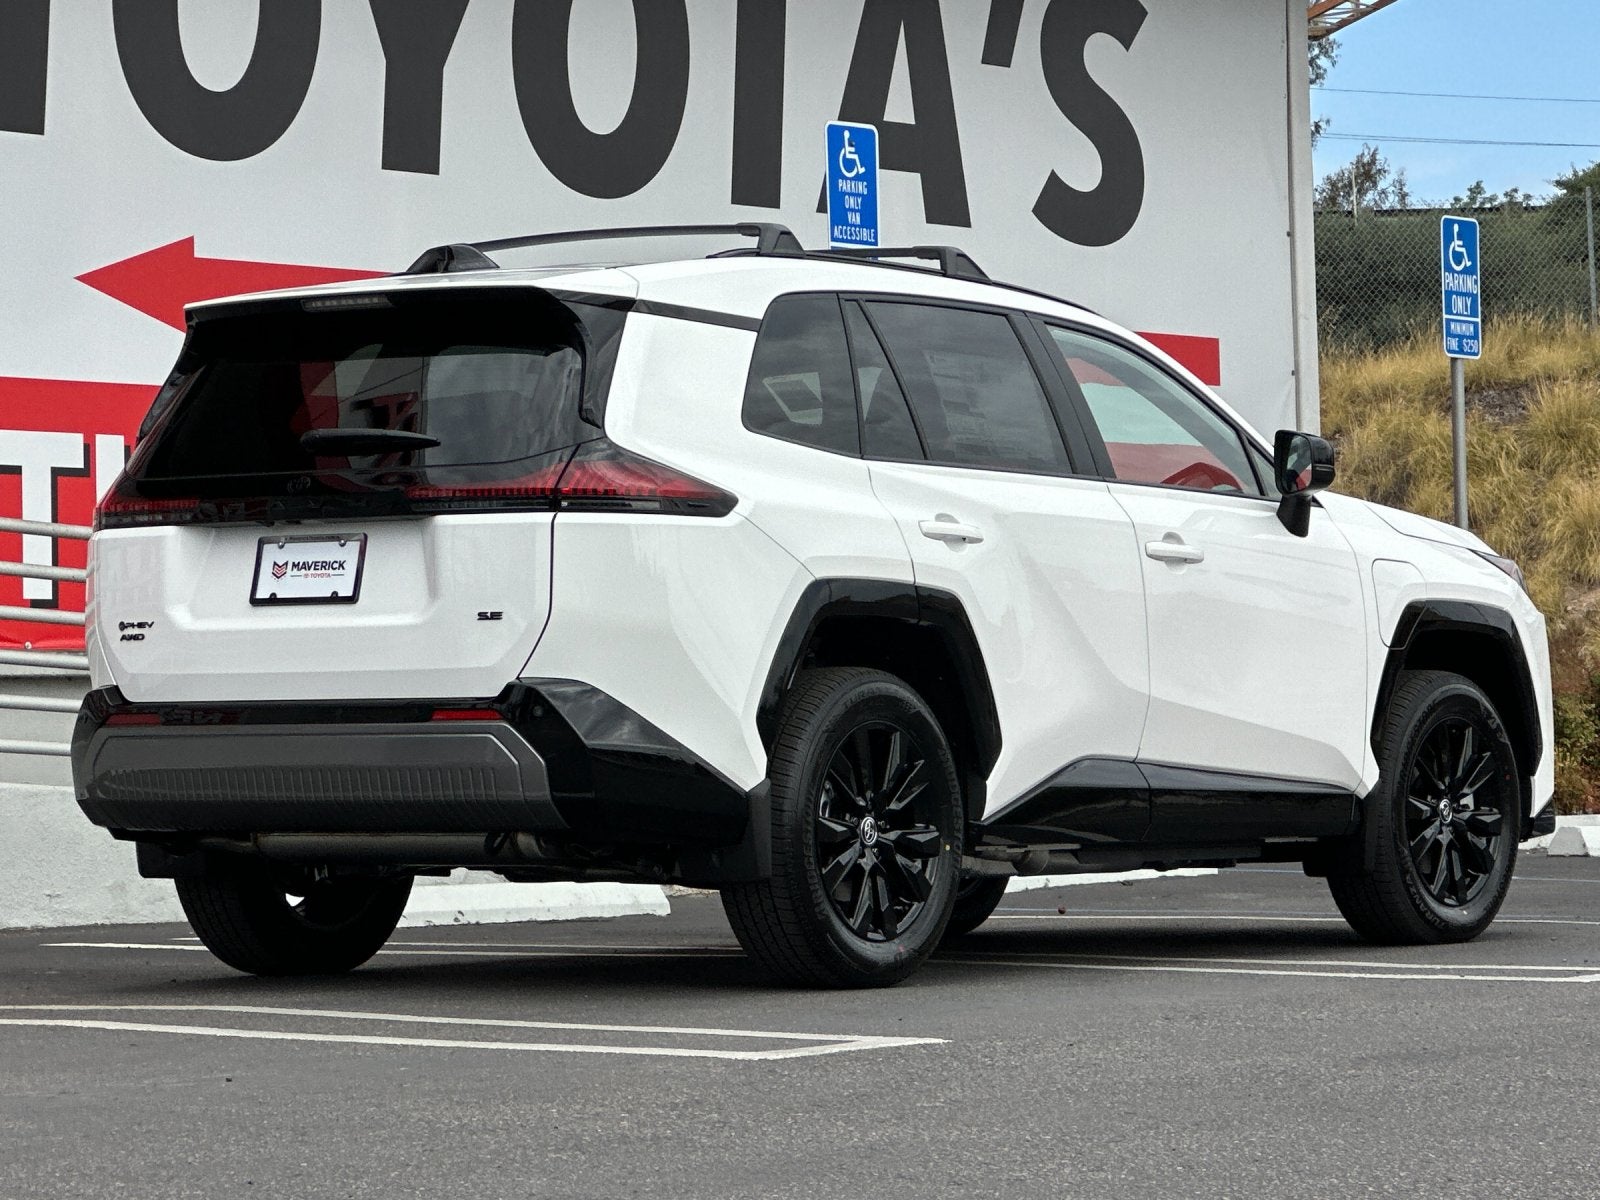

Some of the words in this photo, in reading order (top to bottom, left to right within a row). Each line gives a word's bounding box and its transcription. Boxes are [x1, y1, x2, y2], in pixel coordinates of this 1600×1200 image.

[838, 178, 868, 195] PARKING
[844, 195, 862, 210] ONLY
[847, 211, 861, 225] VAN
[833, 225, 875, 242] ACCESSIBLE
[1445, 271, 1478, 294] PARKING
[1451, 294, 1472, 315] ONLY
[1450, 321, 1475, 336] MINIMUM
[1447, 336, 1459, 351] FINE
[1462, 338, 1478, 353] $250
[291, 560, 347, 571] MAVERICK
[477, 611, 504, 620] SE
[119, 633, 145, 641] AWD
